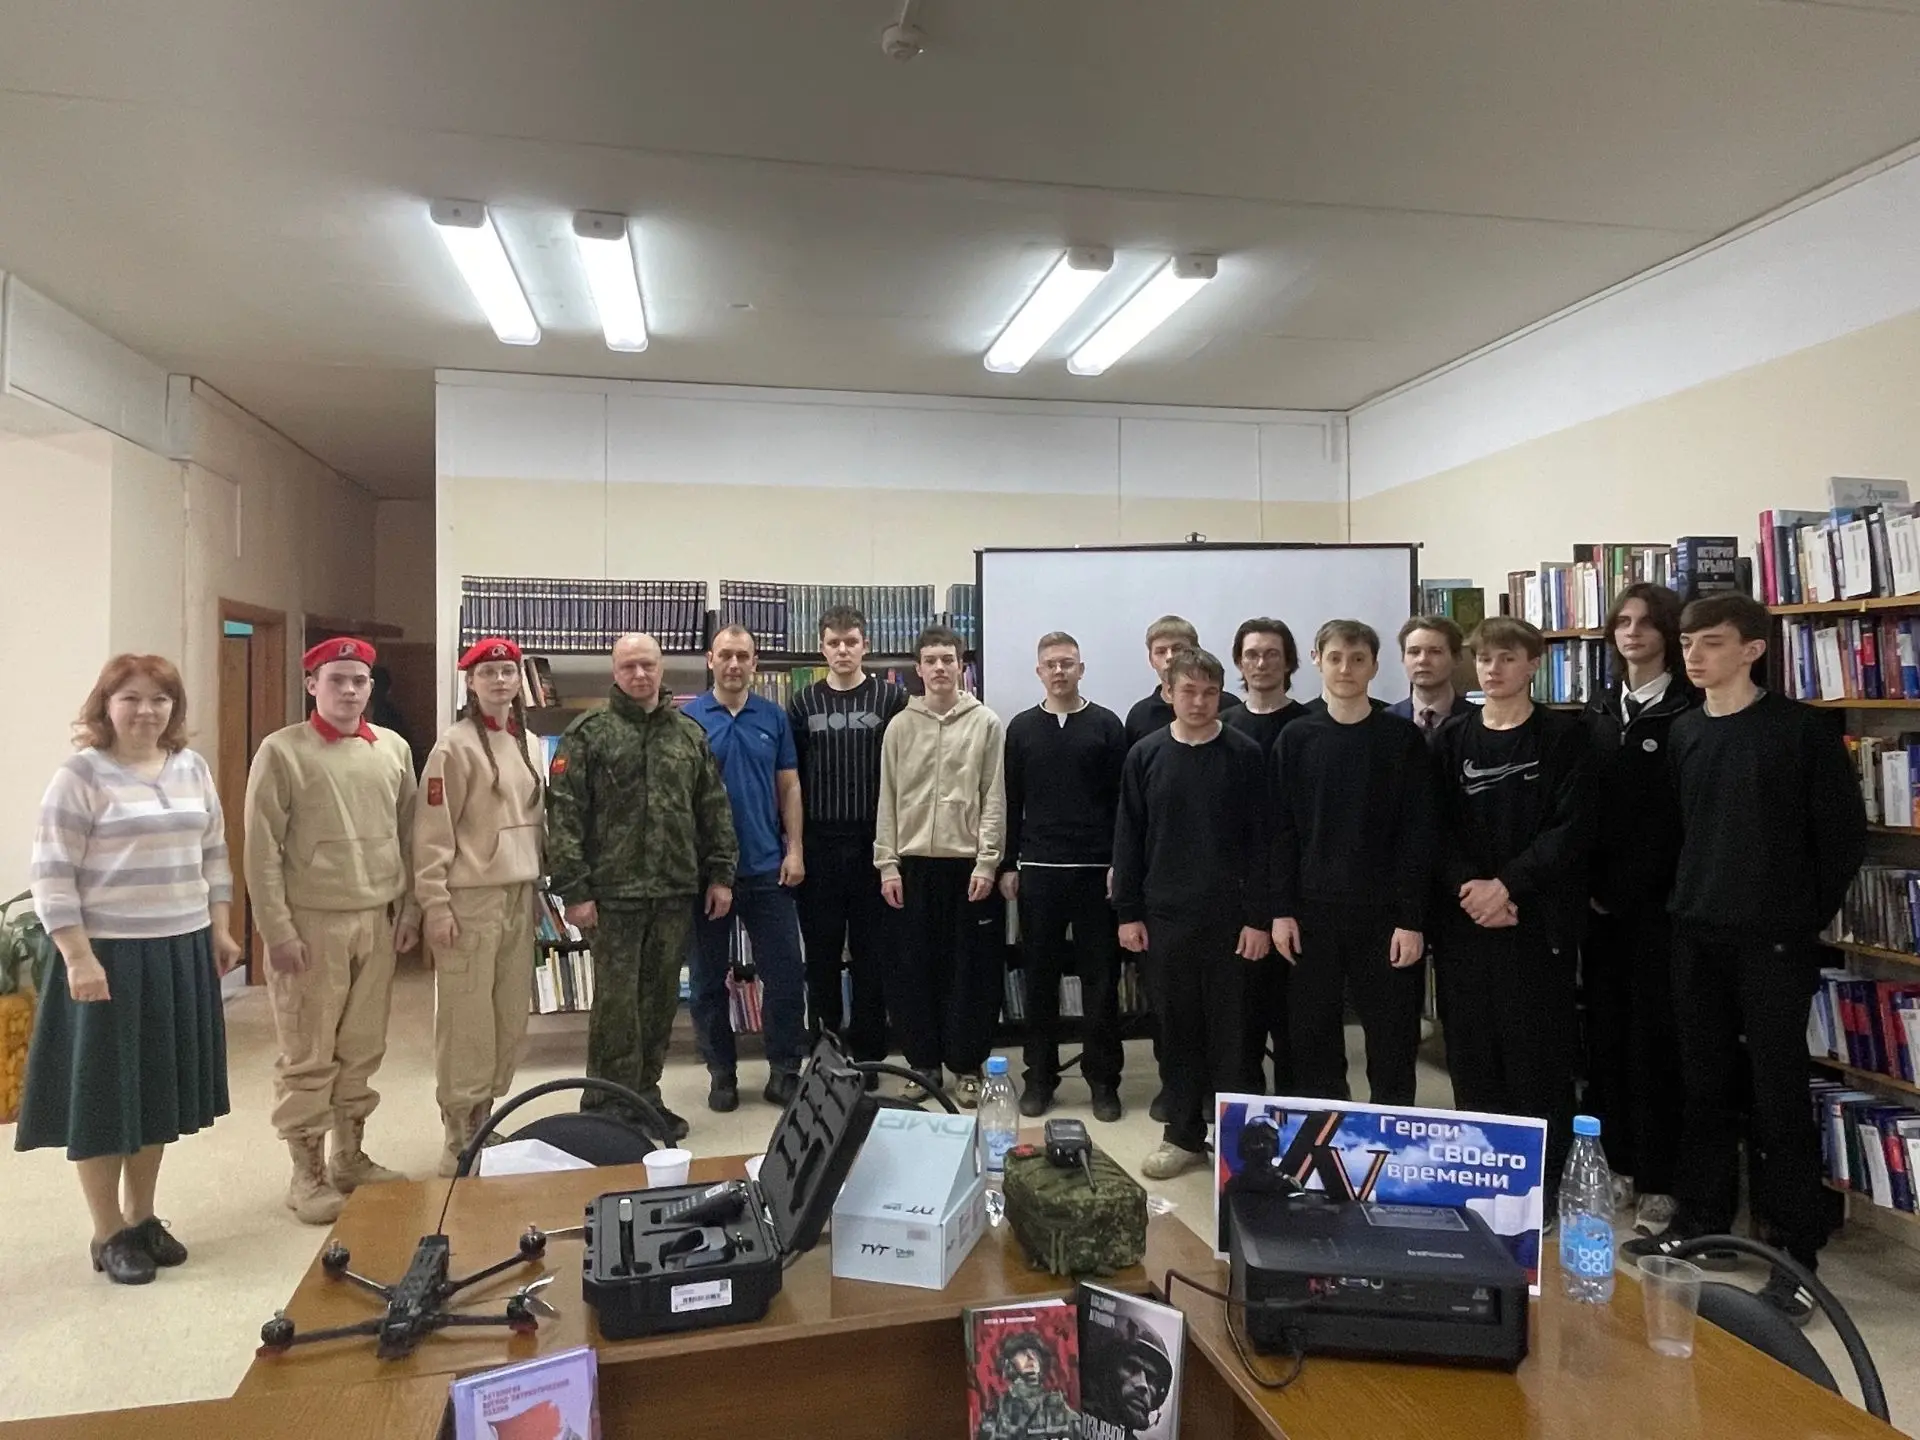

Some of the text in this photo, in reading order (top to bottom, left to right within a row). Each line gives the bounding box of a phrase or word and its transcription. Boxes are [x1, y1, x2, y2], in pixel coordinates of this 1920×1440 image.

[1696, 559, 1735, 573] КРЫМА
[1379, 1115, 1460, 1139] Герои
[1428, 1144, 1527, 1170] СВОего
[1387, 1162, 1510, 1189] времени
[861, 1243, 890, 1256] TYT
[1578, 1245, 1610, 1261] bon
